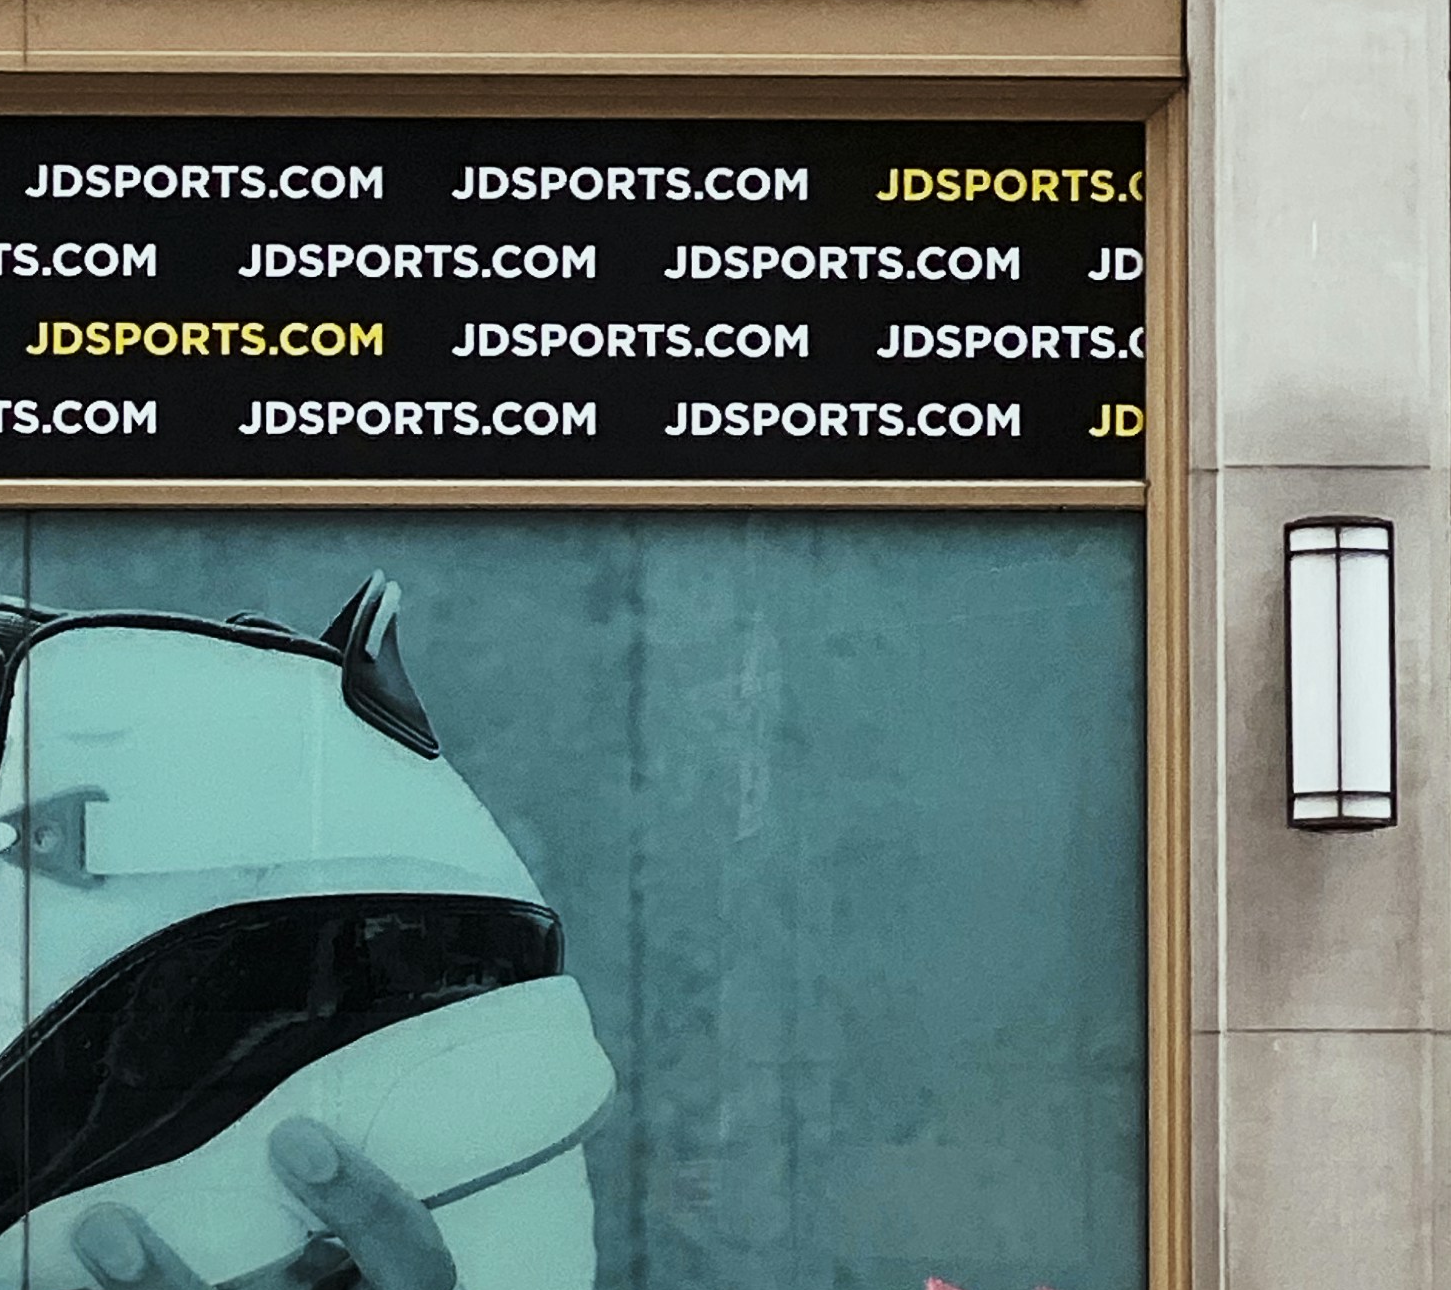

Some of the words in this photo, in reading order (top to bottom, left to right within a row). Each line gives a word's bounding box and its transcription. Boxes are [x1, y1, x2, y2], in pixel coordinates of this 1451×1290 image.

[24, 164, 383, 199] JDSPORTS.COM
[451, 166, 808, 201] JDSPORTS.COM
[238, 244, 596, 279] JDSPORTS.COM
[663, 245, 1020, 281] JDSPORTS.COM
[25, 321, 383, 357] JDSPORTS.COM
[451, 323, 809, 358] JDSPORTS.COM
[238, 401, 597, 436] JDSPORTS.COM
[664, 402, 1021, 437] JDSPORTS.COM
